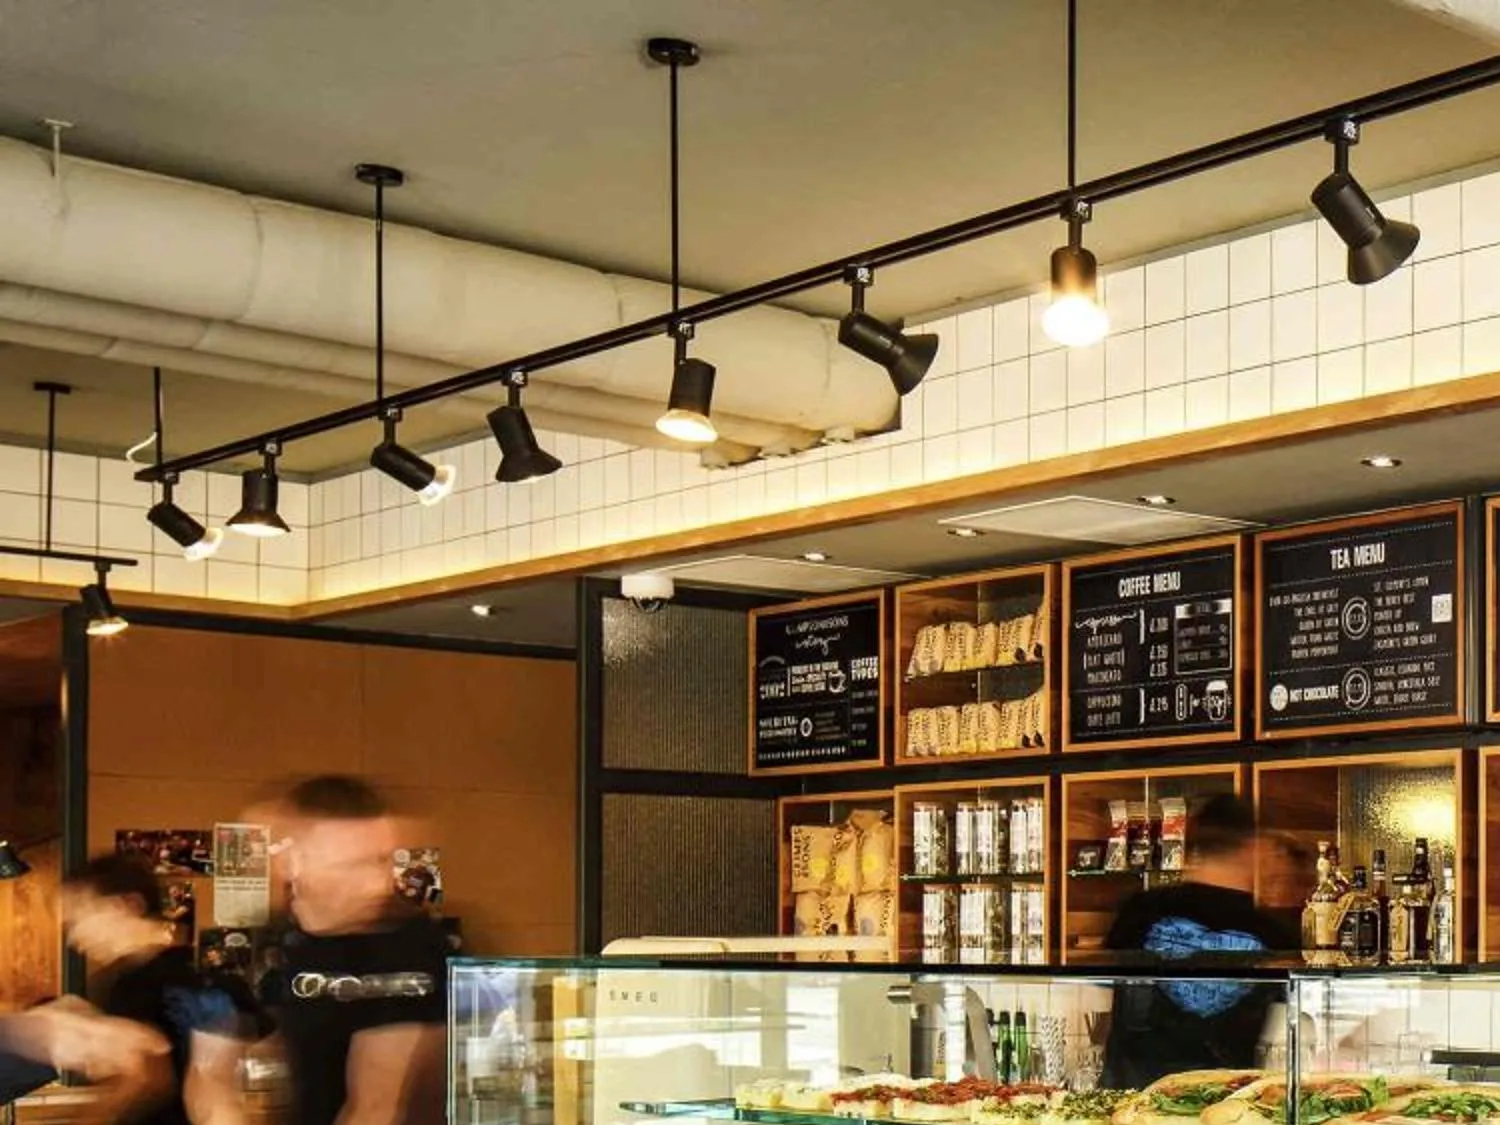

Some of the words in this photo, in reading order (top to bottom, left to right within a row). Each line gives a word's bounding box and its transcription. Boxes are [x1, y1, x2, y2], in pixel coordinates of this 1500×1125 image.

[1329, 547, 1351, 571] TEA
[1353, 541, 1385, 568] MENU
[1118, 575, 1151, 599] COFFEE
[1153, 570, 1181, 593] MENU
